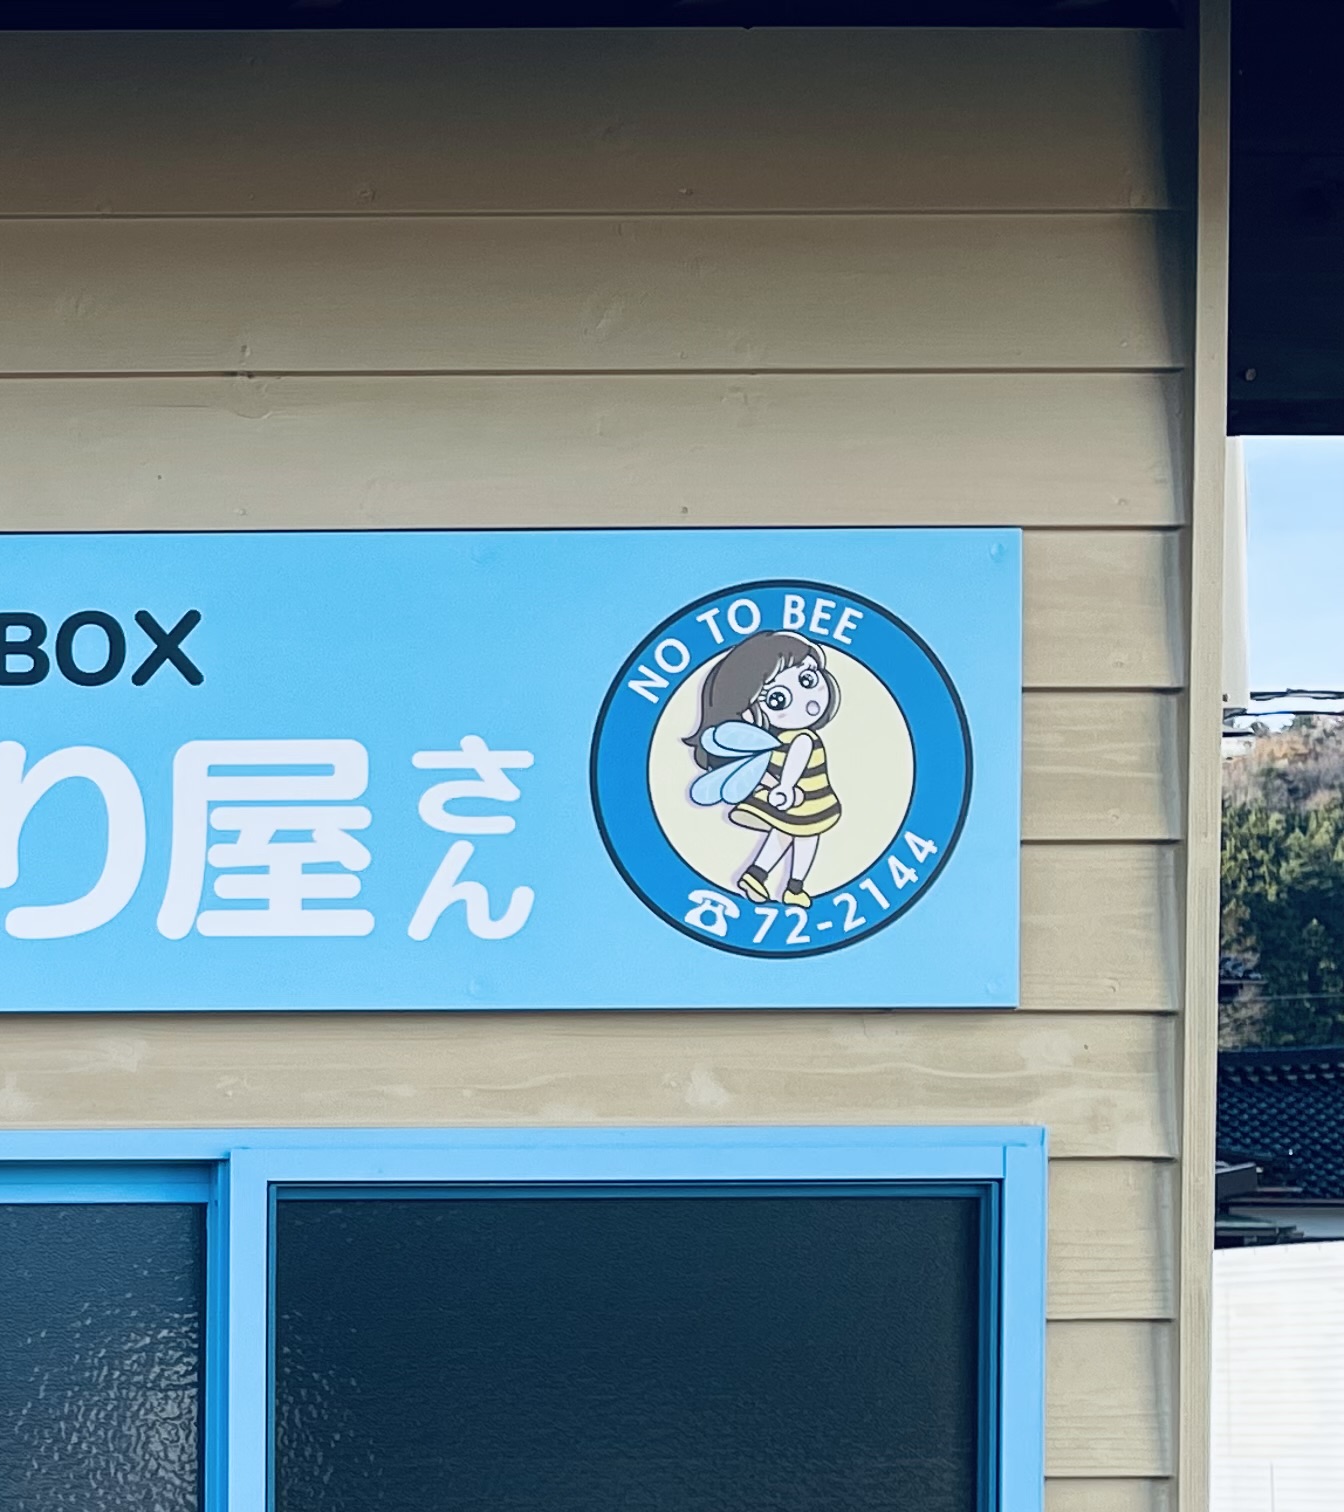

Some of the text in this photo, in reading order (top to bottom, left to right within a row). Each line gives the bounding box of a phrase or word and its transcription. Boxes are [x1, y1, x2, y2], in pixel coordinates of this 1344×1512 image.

[627, 594, 864, 704] NO TO BEE
[407, 734, 535, 942] さん
[752, 830, 938, 944] 72-2144
